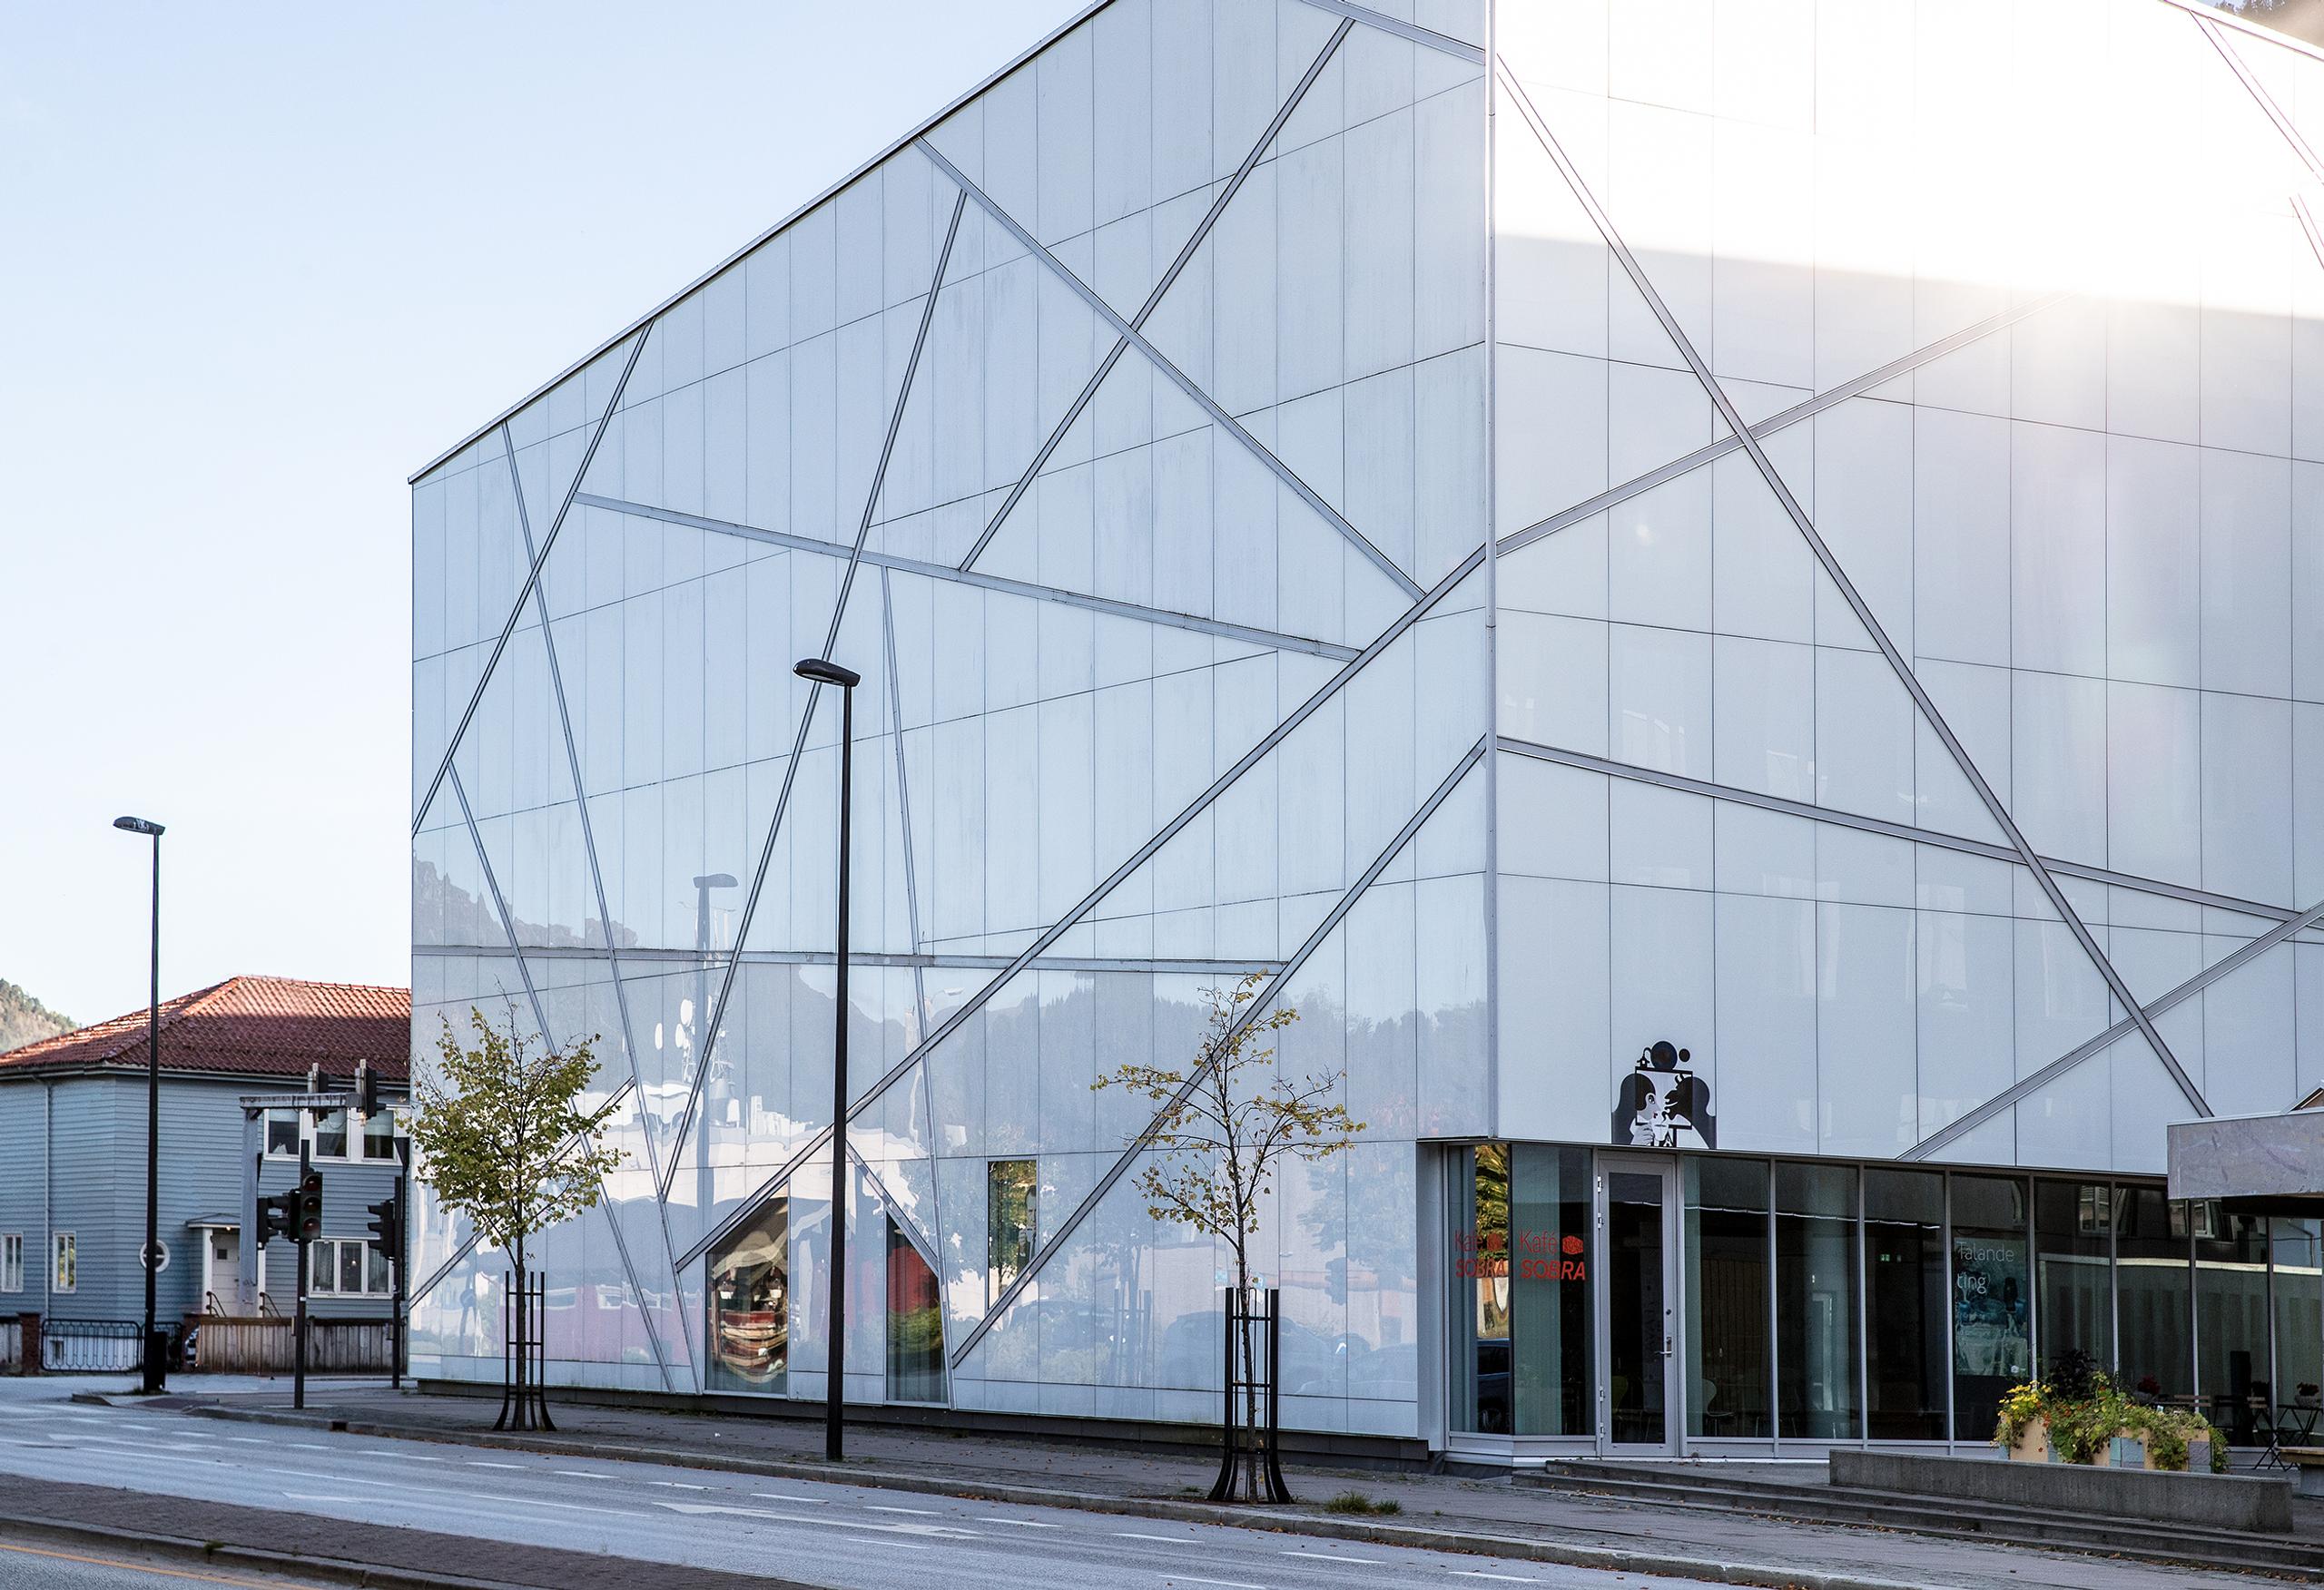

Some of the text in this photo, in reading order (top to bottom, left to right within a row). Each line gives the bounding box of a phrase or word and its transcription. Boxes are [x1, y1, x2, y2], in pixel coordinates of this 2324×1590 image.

[1520, 1229, 1558, 1255] Kafé
[1955, 1241, 2014, 1262] Talande
[1455, 1257, 1506, 1278] SOBRA
[1521, 1259, 1586, 1281] SOBRA
[1956, 1271, 1987, 1294] ting
